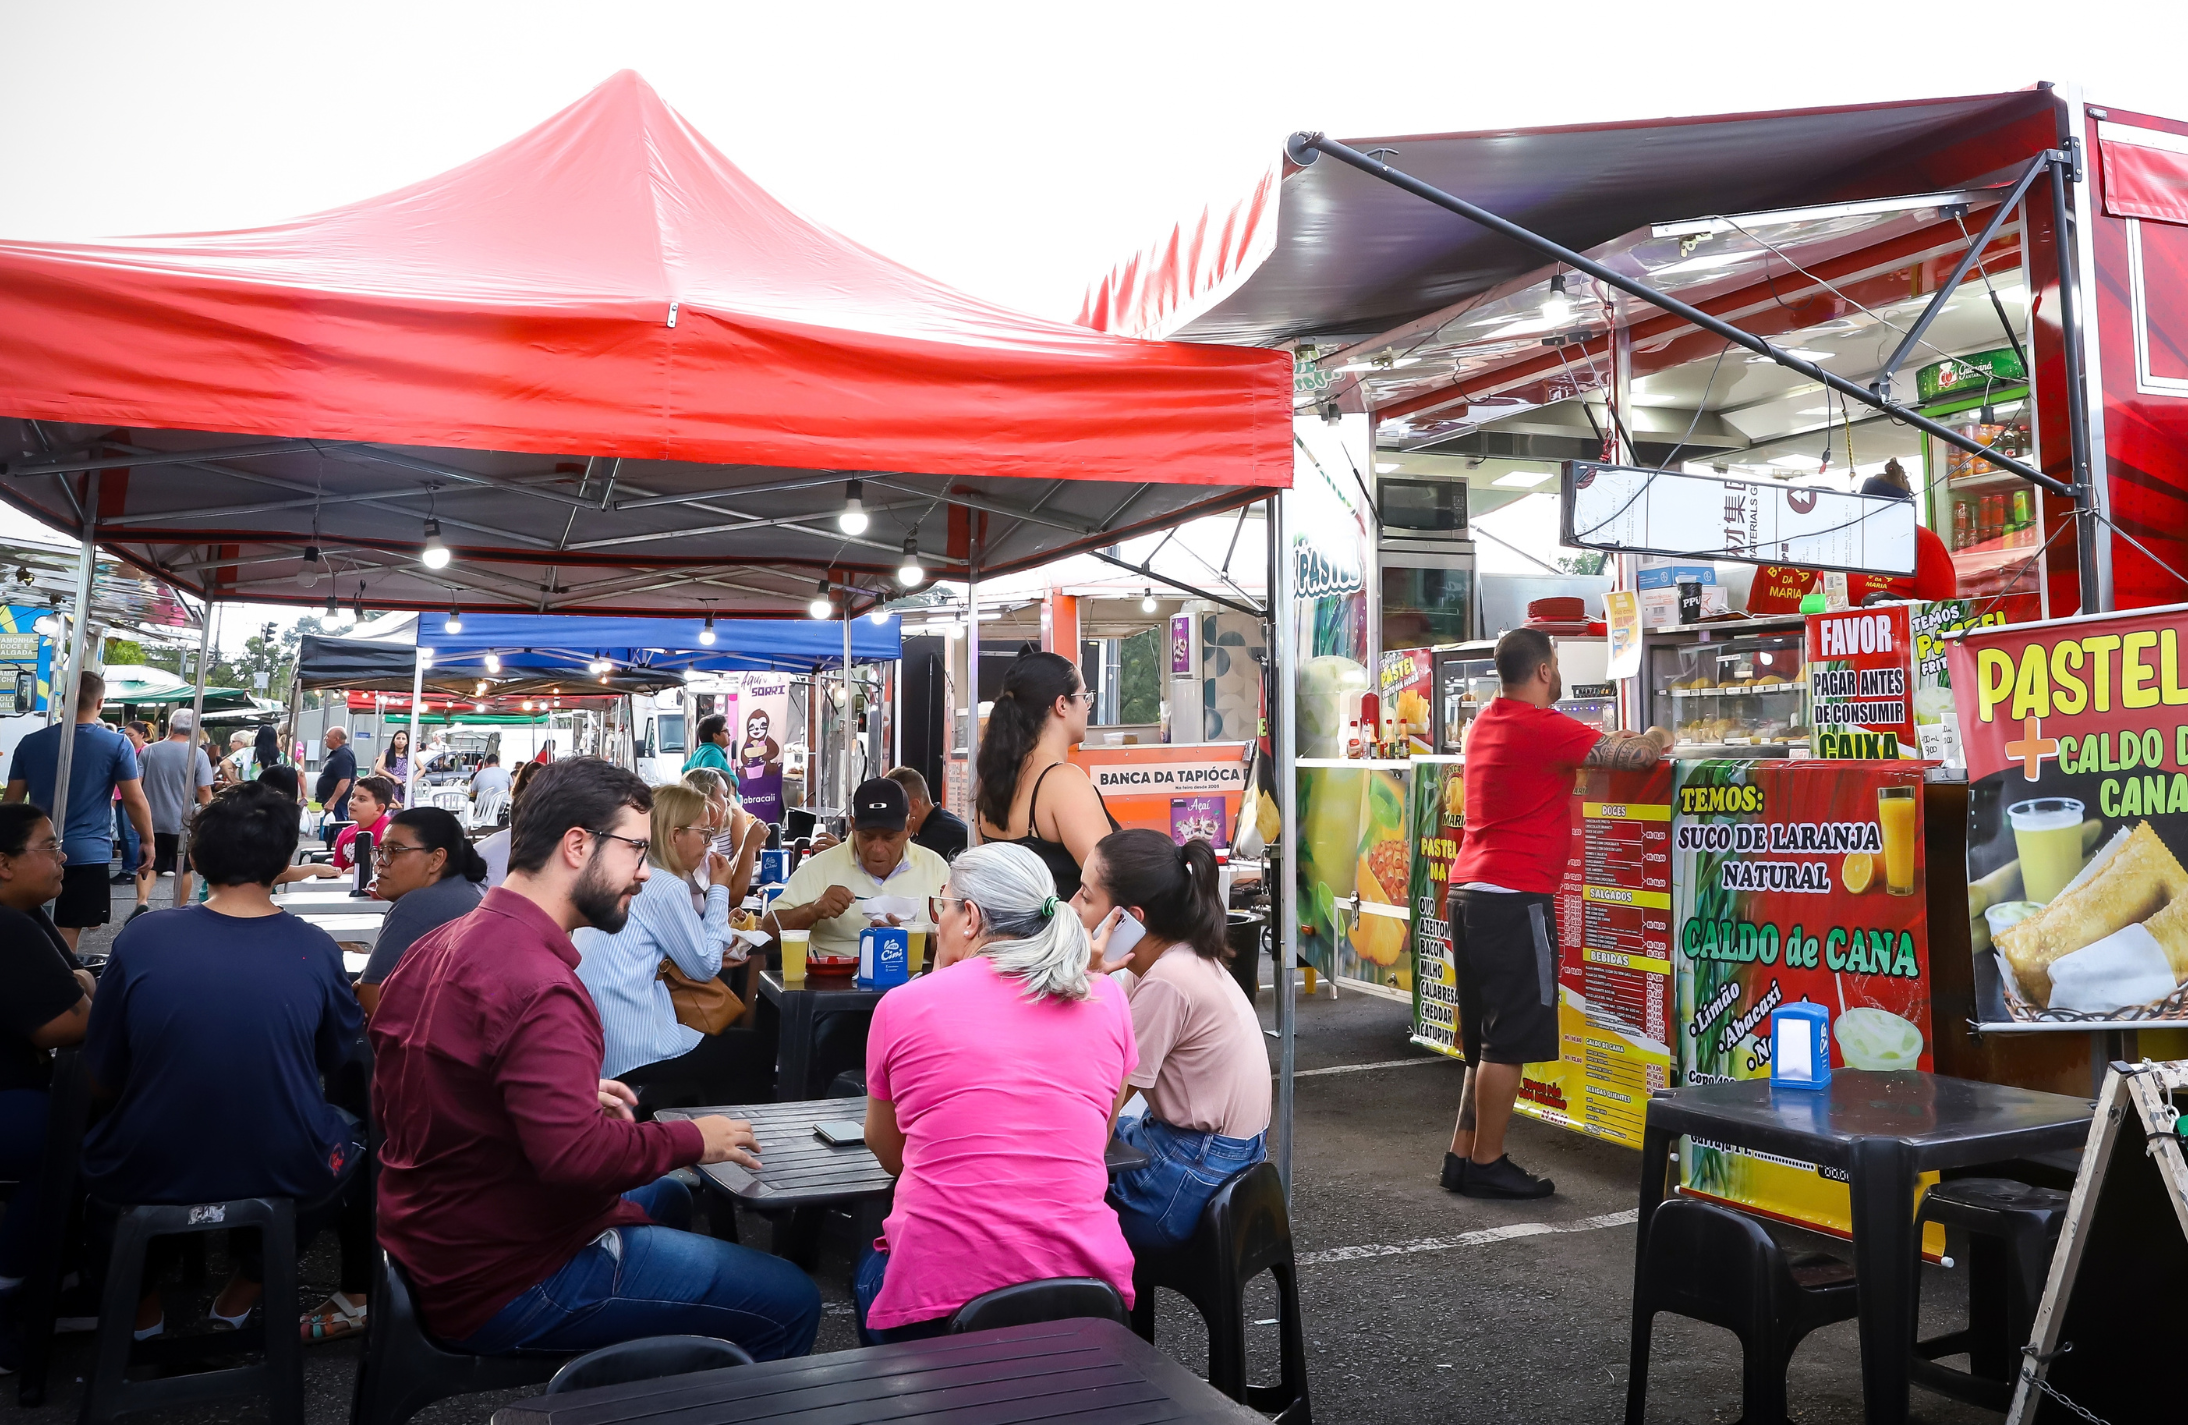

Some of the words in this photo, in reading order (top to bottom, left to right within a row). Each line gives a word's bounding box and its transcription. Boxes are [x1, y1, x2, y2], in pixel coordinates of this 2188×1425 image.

[1782, 575, 1794, 584] DA
[1769, 586, 1802, 599] MARIA
[1912, 605, 1960, 632] TEMOS
[1820, 615, 1893, 656] FAVOR
[1381, 656, 1416, 689] PASTEL
[1813, 670, 1857, 697] PAGAR
[1860, 668, 1904, 696] ANTES
[1977, 629, 2188, 723] PASTEL
[751, 685, 786, 697] SORRI
[1815, 704, 1830, 724] DE
[1832, 702, 1905, 724] CONSUMIR
[1819, 732, 1900, 759] CAIXA
[2058, 728, 2164, 775] CALDO
[1100, 772, 1151, 786] BANCA
[1154, 771, 1175, 784] DA
[1177, 766, 1240, 783] TAPIÓCA
[1187, 798, 1211, 814] Açaí
[1680, 786, 1764, 813] TEMOS:
[2100, 773, 2188, 818] CANA
[1442, 813, 1465, 827] MARI
[1602, 805, 1626, 817] DOCES
[1421, 837, 1458, 860] PASTEL
[1678, 824, 1732, 850] SUCO
[1736, 825, 1767, 850] DE
[1771, 824, 1881, 851] LARANJA
[1430, 862, 1446, 881] NA
[1722, 864, 1830, 891] NATURAL
[1419, 897, 1435, 915] OVO
[1590, 888, 1632, 902] SALGADOS
[1420, 939, 1445, 959] BACON
[1590, 951, 1629, 966] BEBIDAS
[1682, 919, 1781, 965] CALDO
[1785, 926, 1819, 968] de
[1825, 928, 1919, 977] CANA
[1420, 960, 1443, 980] MILHO
[1420, 981, 1459, 1005] CALABRESA
[1420, 1001, 1453, 1025] CHEDDAR
[1695, 981, 1741, 1033] Limão
[1724, 979, 1783, 1049] Abacaxi
[1420, 1022, 1454, 1047] CATUPIRY
[1586, 1038, 1601, 1048] CALDO
[1586, 1085, 1606, 1097] BEBIDAS
